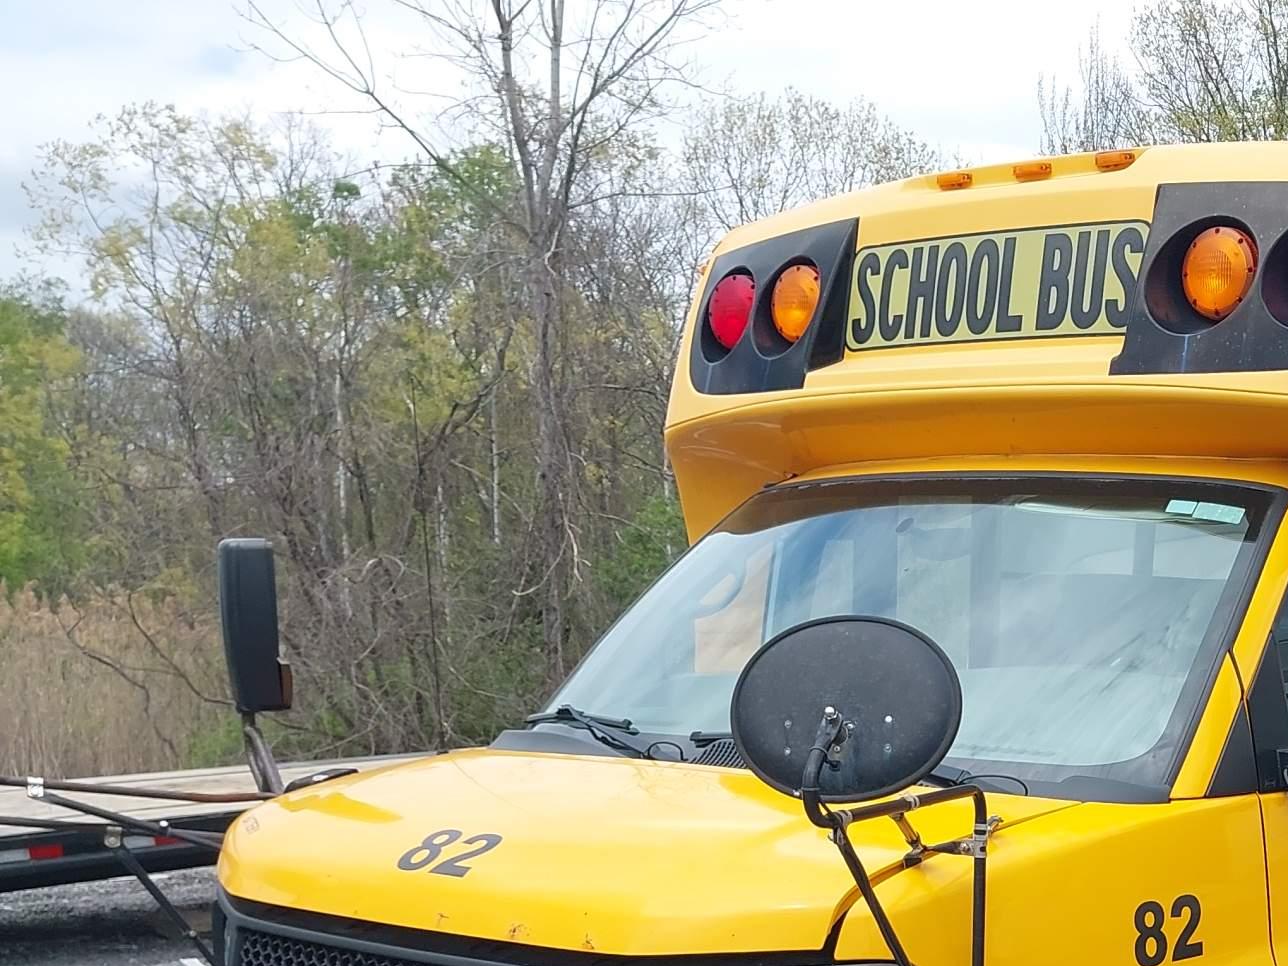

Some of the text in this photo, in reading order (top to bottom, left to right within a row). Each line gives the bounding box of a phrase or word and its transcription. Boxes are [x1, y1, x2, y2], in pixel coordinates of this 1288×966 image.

[852, 227, 1146, 345] SCHOOL BUS
[397, 829, 504, 878] 82
